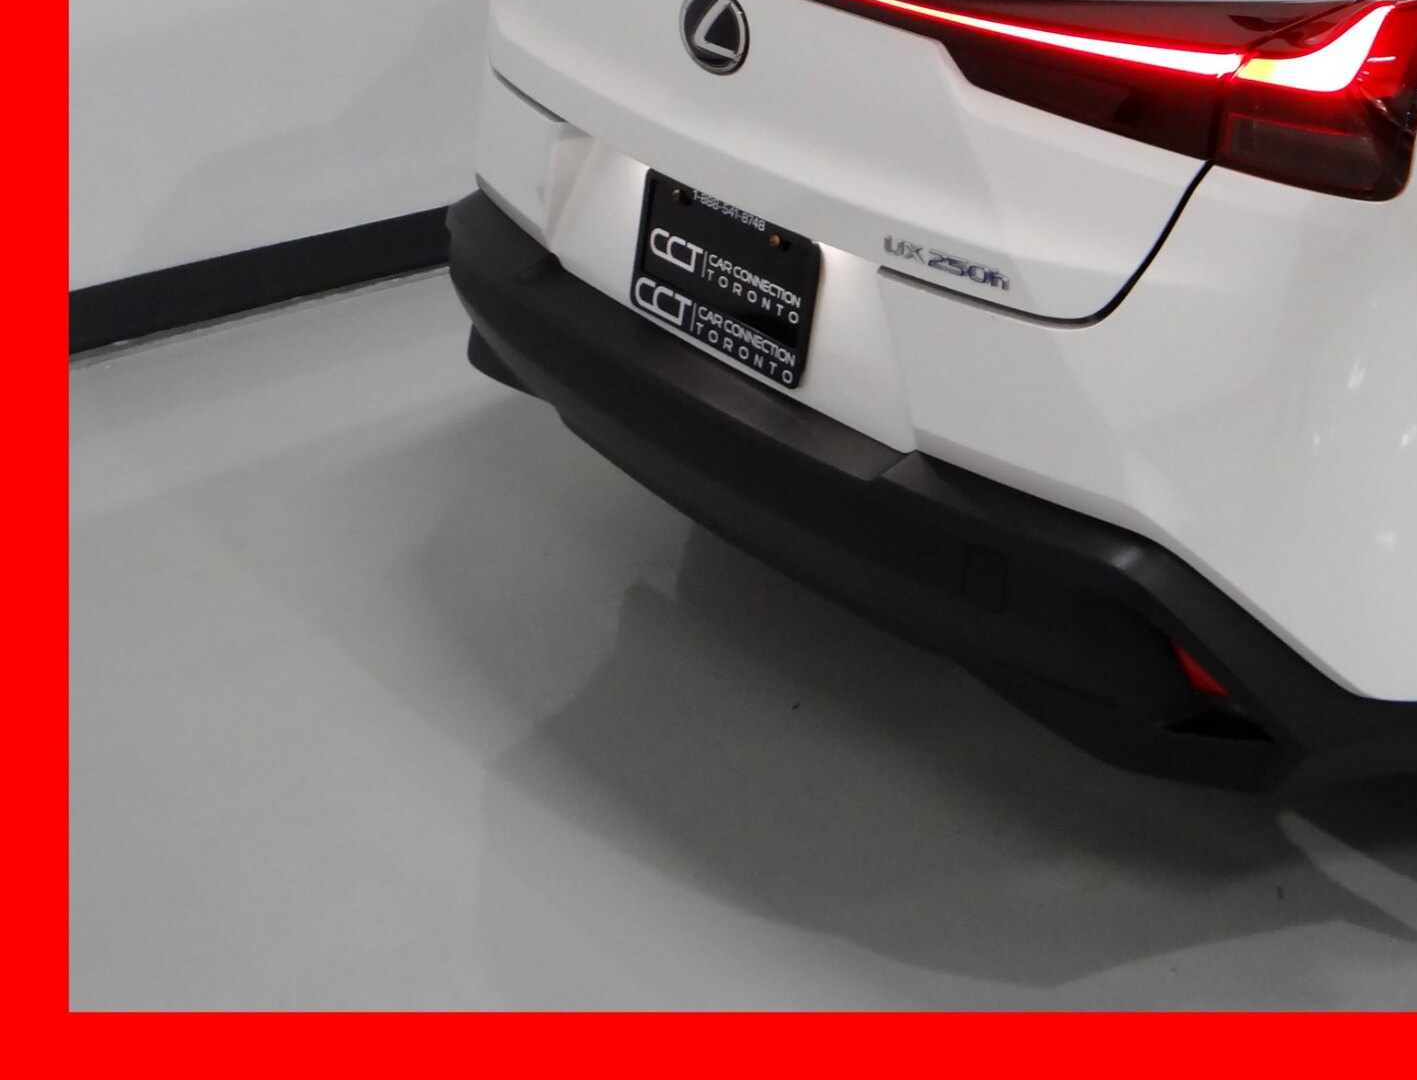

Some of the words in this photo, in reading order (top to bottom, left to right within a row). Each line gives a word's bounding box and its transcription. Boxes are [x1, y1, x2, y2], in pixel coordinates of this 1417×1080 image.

[650, 227, 703, 272] CCT
[884, 234, 925, 265] UX
[635, 276, 692, 326] CCT
[706, 269, 800, 325] TORONTO
[708, 254, 733, 275] CAR
[733, 266, 802, 308] CONNECTION
[695, 322, 794, 384] TORONTO
[697, 305, 723, 329] CAR
[723, 318, 796, 367] CONNECTION
